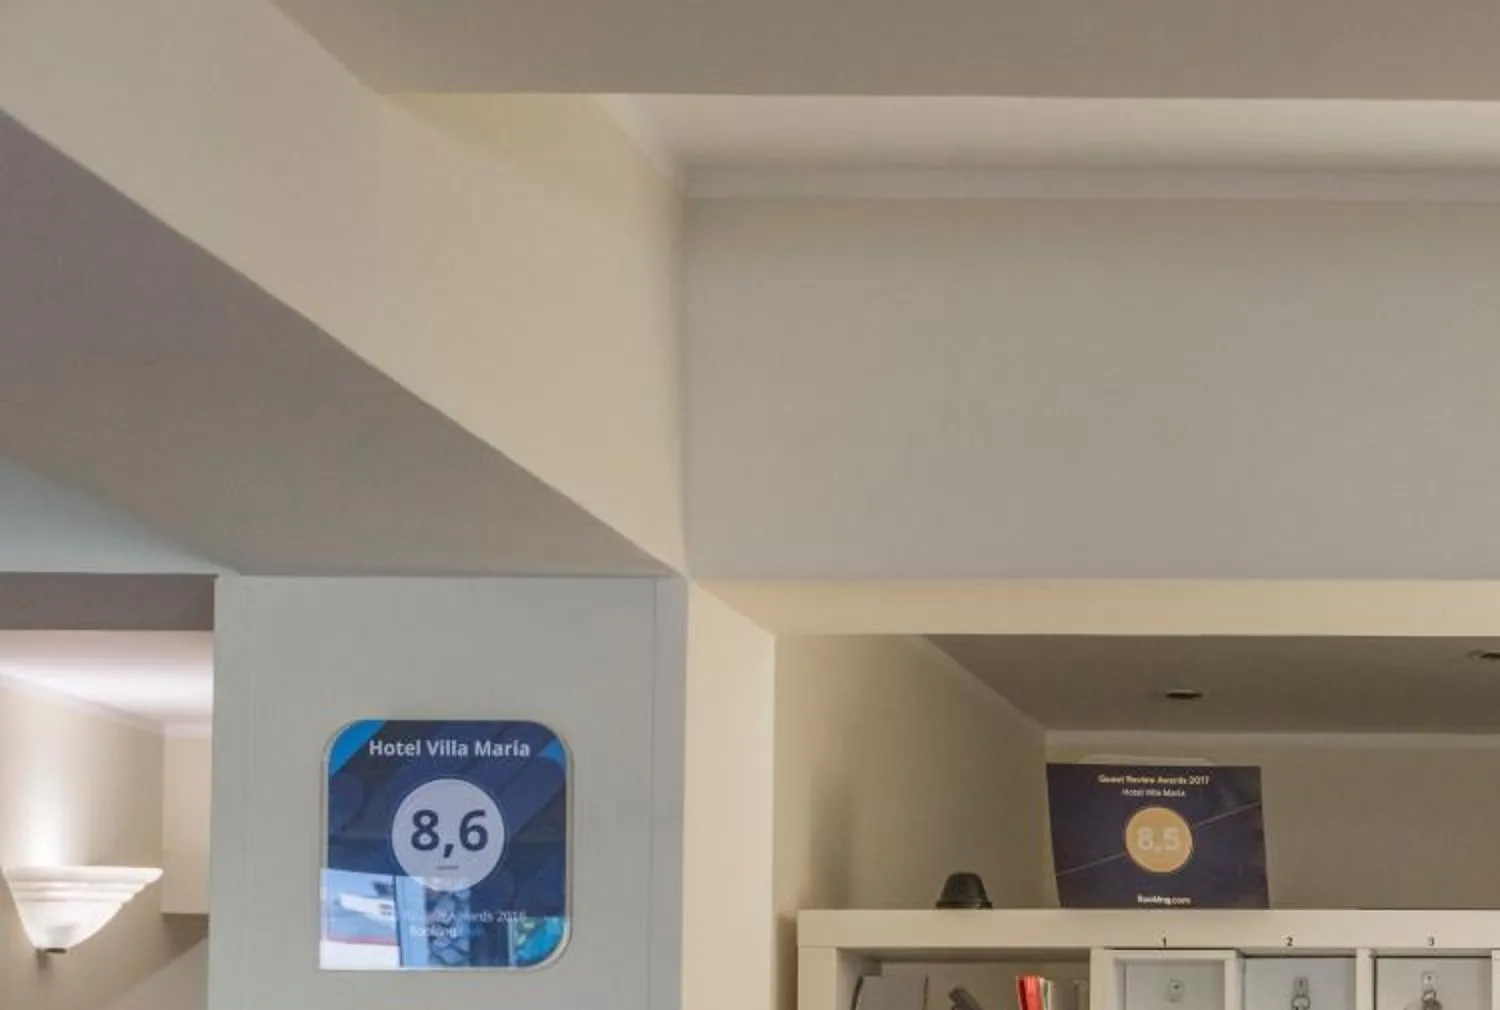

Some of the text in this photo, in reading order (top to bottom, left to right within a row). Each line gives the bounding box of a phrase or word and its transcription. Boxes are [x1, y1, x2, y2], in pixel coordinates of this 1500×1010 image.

[368, 739, 532, 758] Hotel Villa Maria
[410, 809, 489, 859] 8,6
